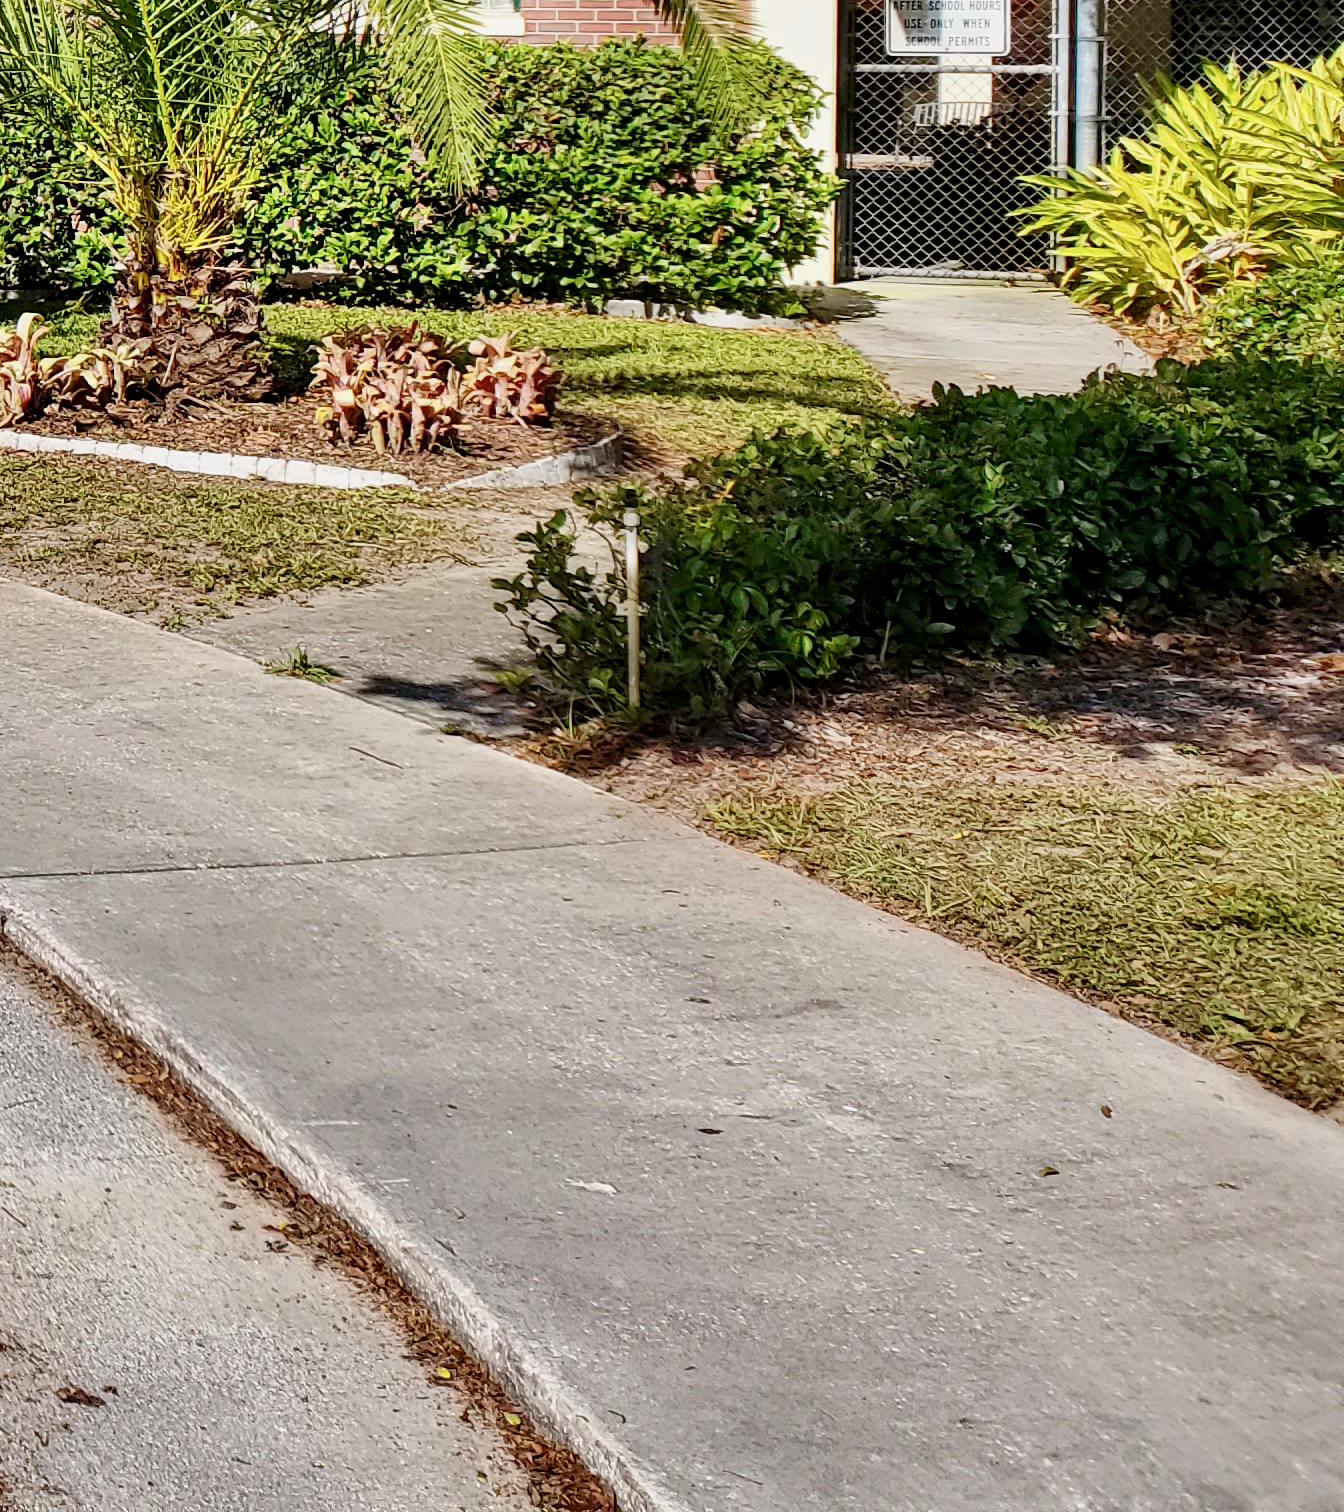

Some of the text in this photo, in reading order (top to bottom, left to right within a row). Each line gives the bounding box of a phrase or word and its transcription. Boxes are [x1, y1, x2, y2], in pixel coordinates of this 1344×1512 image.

[893, 0, 1001, 11] AFTER SCHOOL HOURS
[904, 18, 990, 29] USE ONLY WHEN
[905, 36, 990, 47] SCHOOL PERMITS
